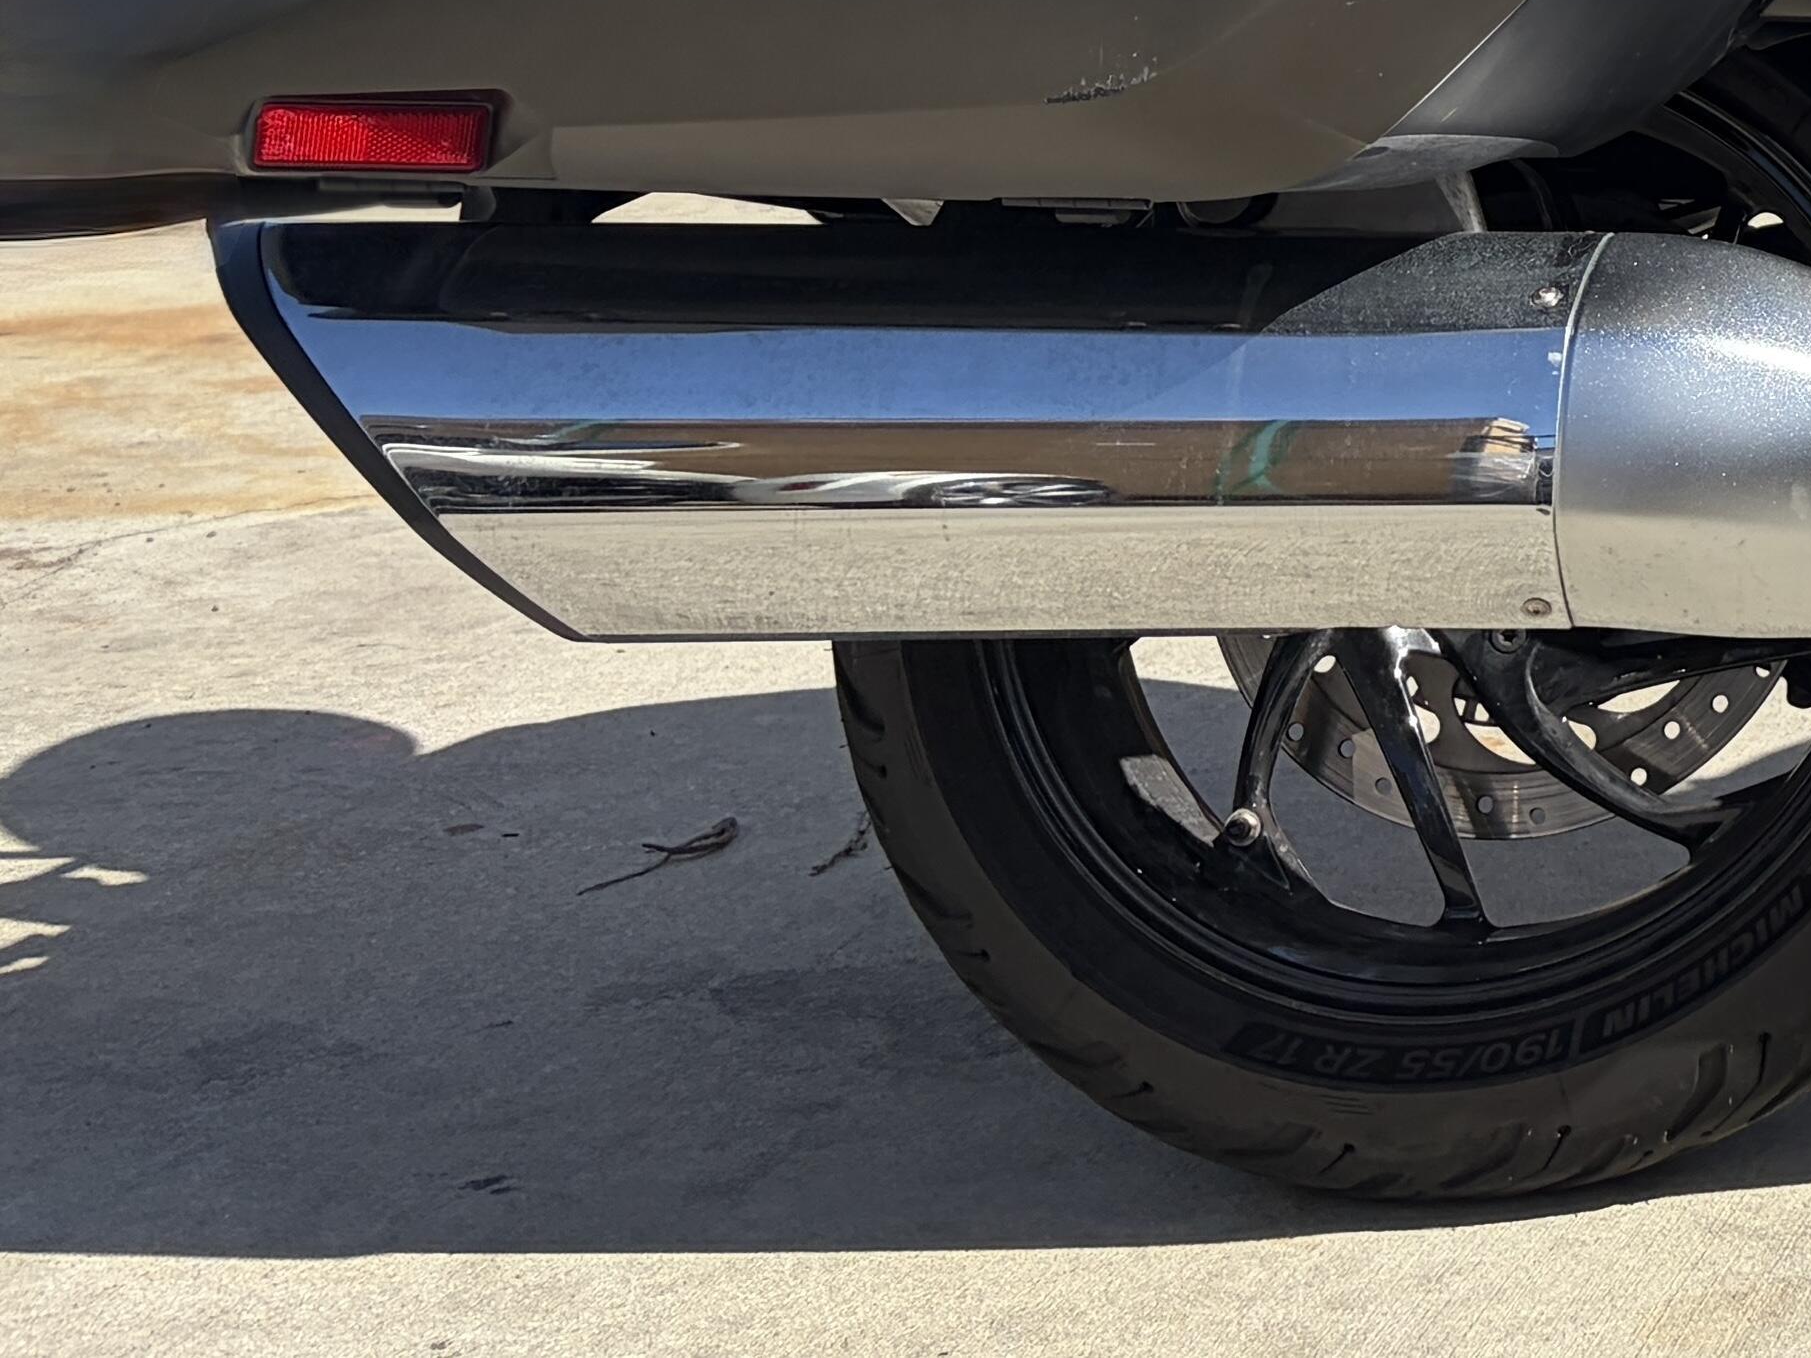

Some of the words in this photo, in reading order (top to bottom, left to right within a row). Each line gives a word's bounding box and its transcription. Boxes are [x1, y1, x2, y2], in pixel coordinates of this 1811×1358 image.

[1602, 890, 1803, 1036] MICHELIN
[1253, 1033, 1299, 1065] 17
[1314, 1042, 1382, 1078] ZR
[1399, 1029, 1565, 1080] 190/55
